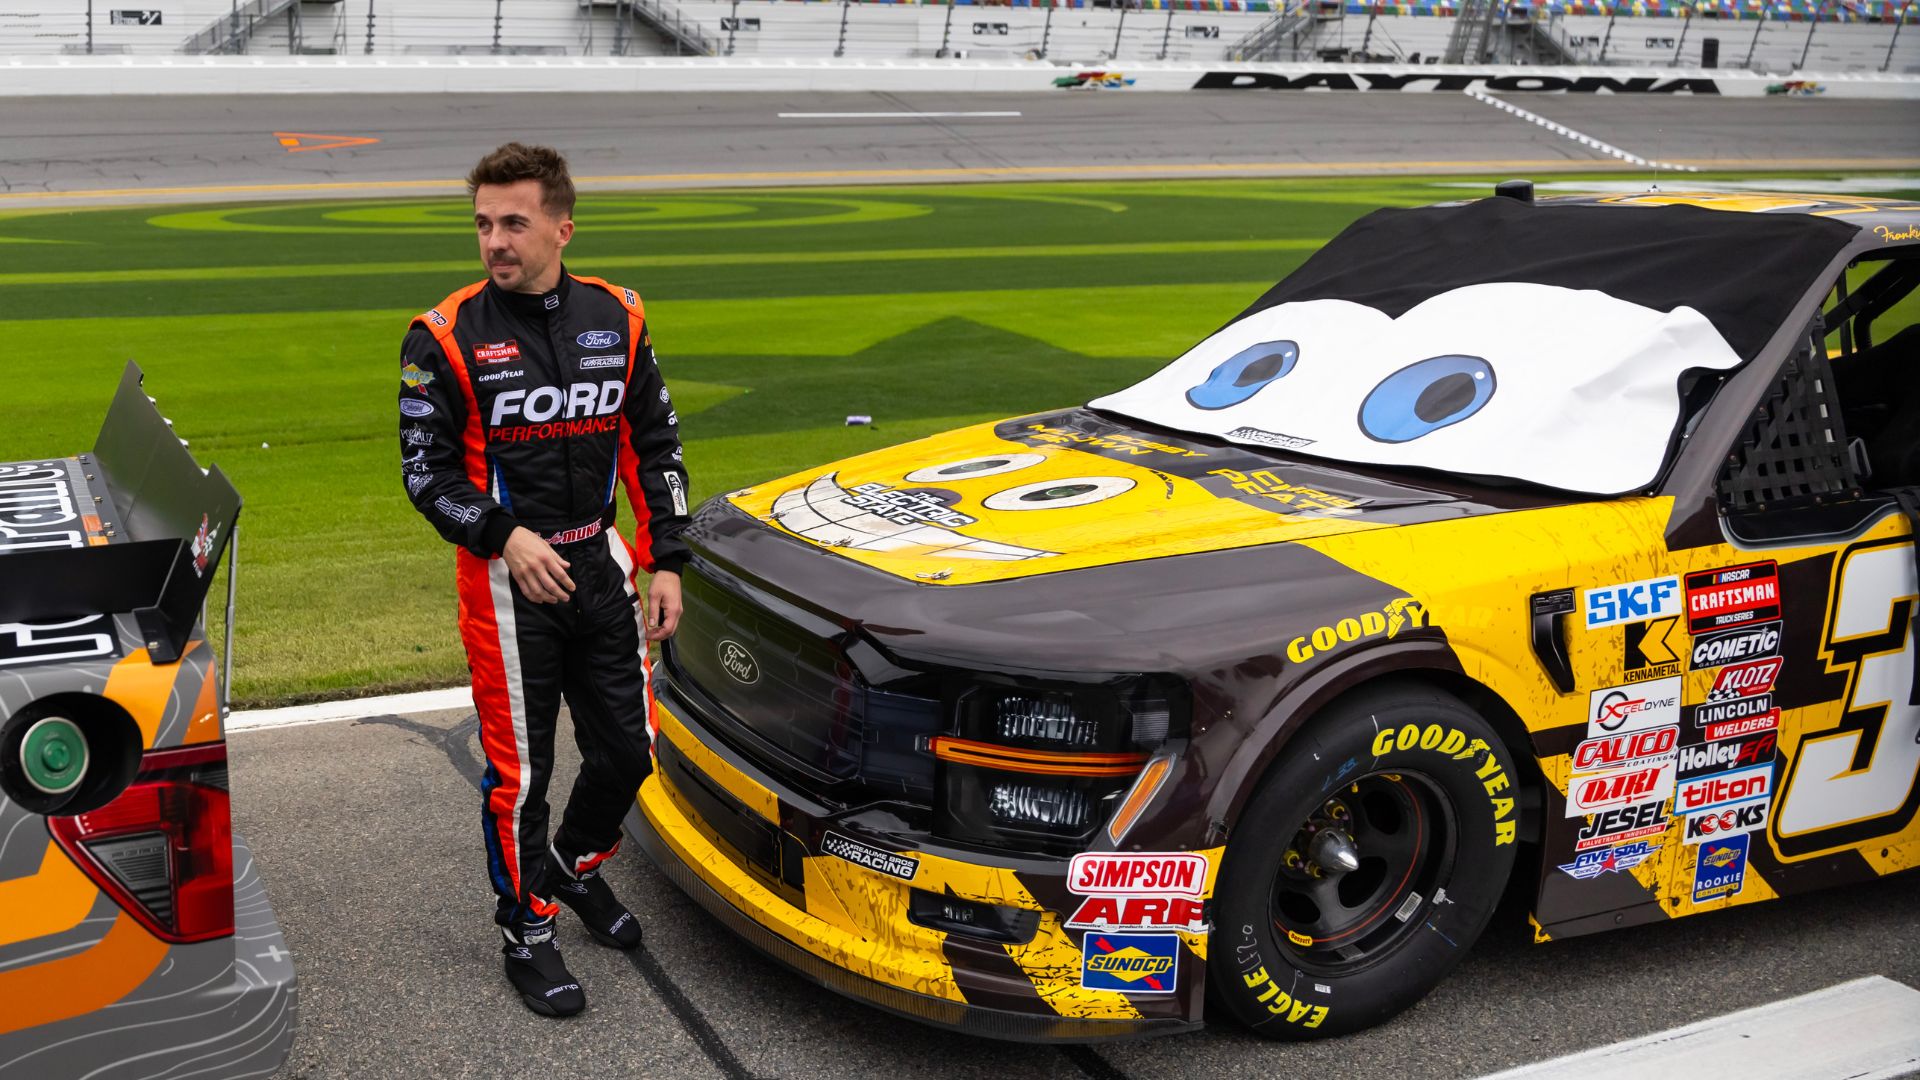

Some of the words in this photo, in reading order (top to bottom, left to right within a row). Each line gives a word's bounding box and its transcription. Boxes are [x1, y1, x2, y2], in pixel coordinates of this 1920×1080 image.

[1192, 71, 1721, 96] DAYTONA
[585, 333, 612, 345] Ford
[477, 348, 518, 358] CRAFTSMAN
[479, 370, 524, 381] GOODYEAR
[490, 380, 626, 426] FORD
[489, 415, 620, 442] PERFORMANCE
[844, 495, 915, 525] STATE
[852, 482, 978, 527] ELECTRIC
[1721, 569, 1750, 583] NASCAR
[1588, 579, 1678, 625] SKF
[1691, 582, 1776, 611] CRAFTSMAN
[1715, 613, 1734, 624] TRUCK
[1734, 611, 1753, 622] SERIES
[1693, 628, 1778, 663] COMETIC
[724, 643, 752, 680] Ford
[1623, 663, 1681, 683] KENNAMETAL
[1719, 662, 1775, 691] KLOTZ
[1699, 697, 1768, 724] LINCOLN
[1713, 715, 1774, 737] WELDERS
[1574, 728, 1678, 770] CALICO
[1627, 754, 1674, 767] COATINGS
[1679, 741, 1740, 773] Holley
[1737, 735, 1776, 764] EFI
[1371, 724, 1516, 847] GOODYEAR
[1582, 765, 1669, 803] DART
[1683, 775, 1766, 808] tilton
[1580, 801, 1668, 839] JESEL
[1689, 804, 1766, 836] KOOKS
[1582, 834, 1621, 847] VALVETRAIN
[1624, 826, 1662, 839] INNOVATION
[850, 850, 913, 877] RACING
[854, 845, 887, 860] REAUME
[888, 853, 914, 867] BROS
[1575, 849, 1610, 868] FIVE
[1614, 841, 1649, 858] STAR
[1703, 849, 1741, 866] SUNOCO
[1078, 860, 1197, 888] SIMPSON
[1696, 872, 1741, 890] ROOKIE
[609, 912, 631, 935] zamp
[1070, 898, 1203, 926] ARP
[1088, 955, 1172, 974] SUNOCO
[545, 984, 579, 997] zamp
[1243, 966, 1329, 1029] EAGLE
